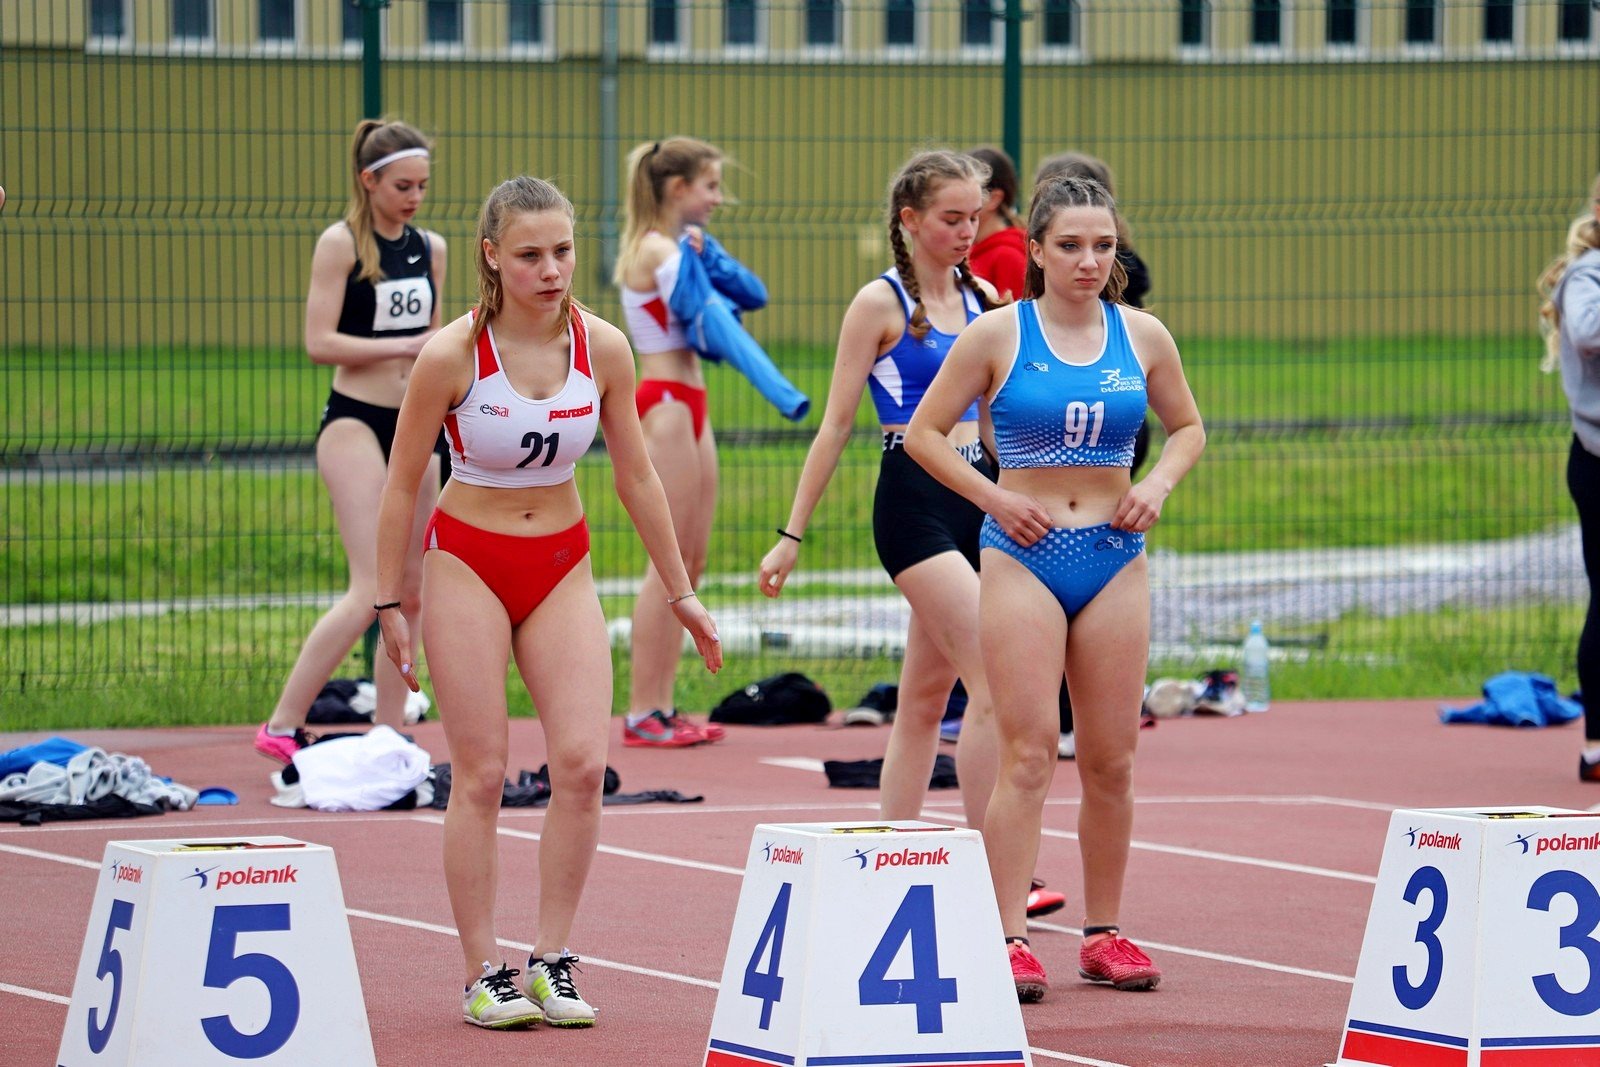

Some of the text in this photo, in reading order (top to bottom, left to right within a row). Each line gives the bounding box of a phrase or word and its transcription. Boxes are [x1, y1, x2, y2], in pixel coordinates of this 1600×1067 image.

[390, 288, 421, 317] 86
[1064, 401, 1105, 448] 91
[516, 431, 560, 469] 21
[771, 846, 803, 865] polanik
[875, 847, 950, 871] polanik
[1418, 830, 1462, 850] polanik
[117, 864, 143, 884] polanik
[216, 864, 298, 890] polanik
[742, 882, 793, 1031] 4
[1392, 865, 1449, 1010] 3
[1526, 869, 1600, 1017] 3
[87, 898, 135, 1055] 5
[859, 884, 958, 1034] 4
[201, 903, 300, 1059] 5
